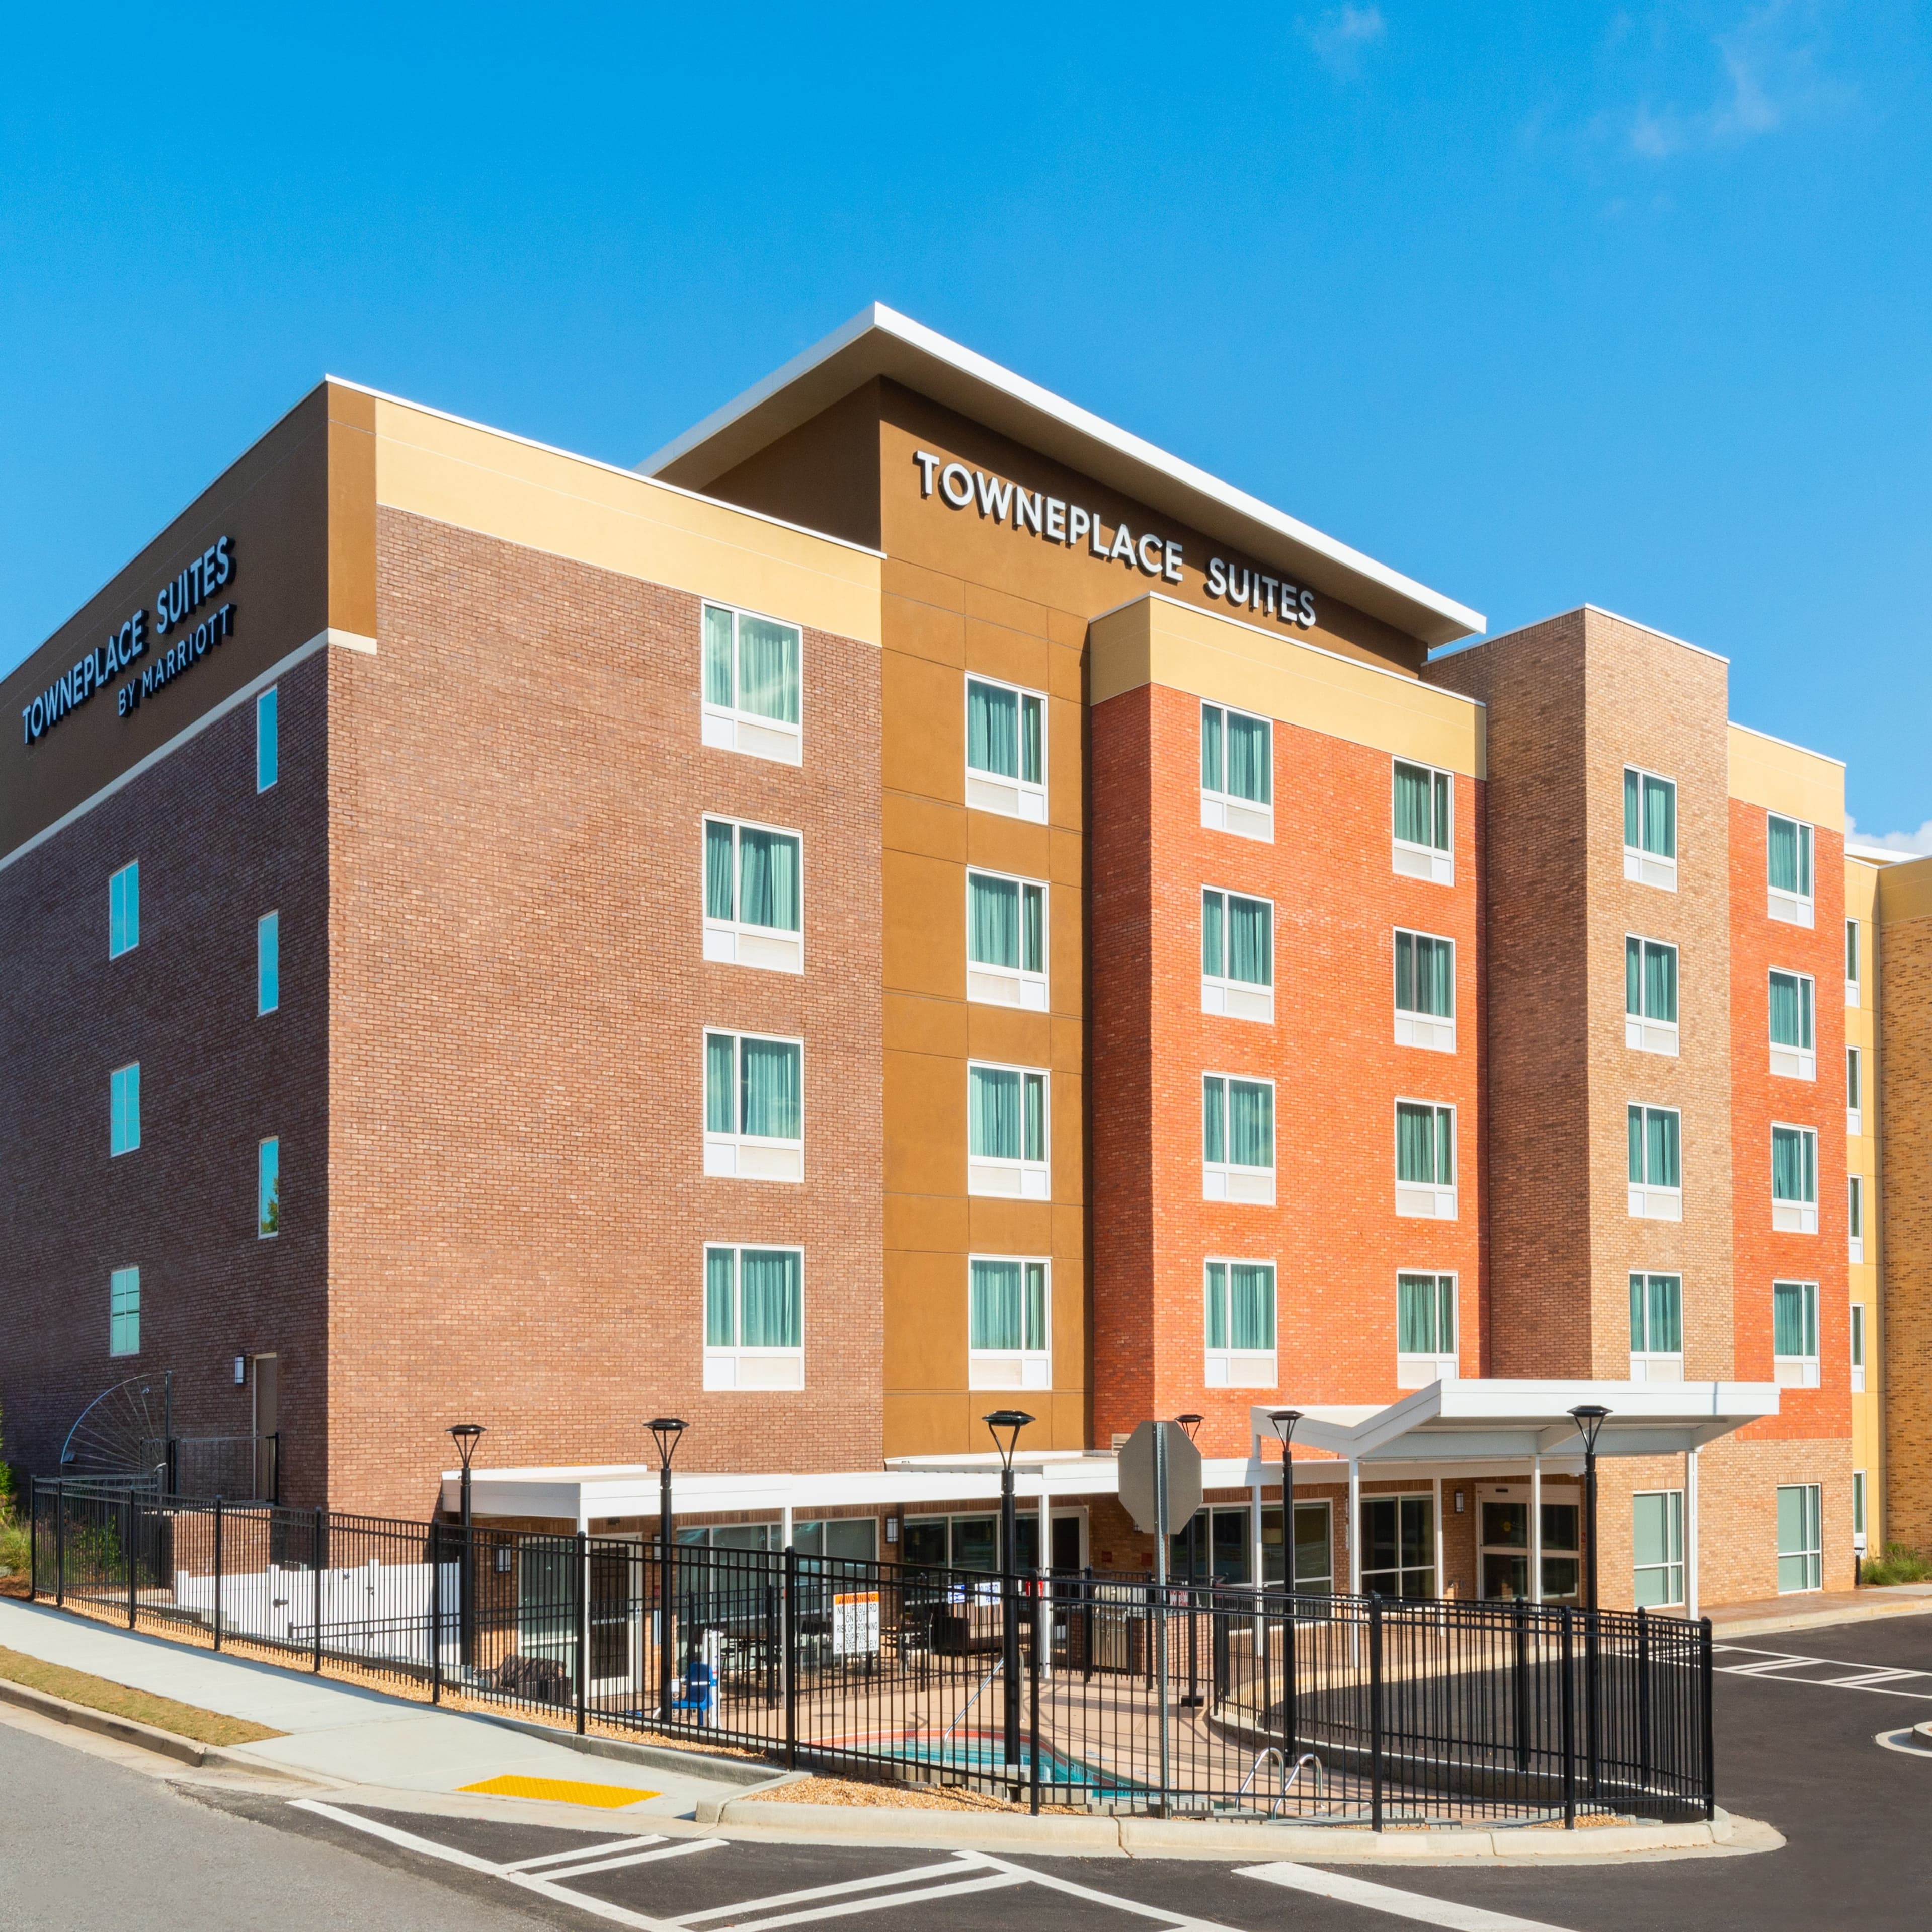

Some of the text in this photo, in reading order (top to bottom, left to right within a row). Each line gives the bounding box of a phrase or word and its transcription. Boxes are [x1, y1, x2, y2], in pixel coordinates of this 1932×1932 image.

[916, 450, 1317, 627] TOWNEPLACE SUITES
[22, 535, 230, 744] TOWNEPLACE SUITES
[118, 603, 230, 717] BY MARRIOTT
[847, 1603, 877, 1614] LIFGURD
[846, 1613, 868, 1623] ON DUT
[848, 1623, 854, 1632] OF
[855, 1622, 877, 1631] ROWING
[845, 1632, 868, 1642] SUPRVIS
[837, 1639, 877, 1651] CHDRE CLOELY
